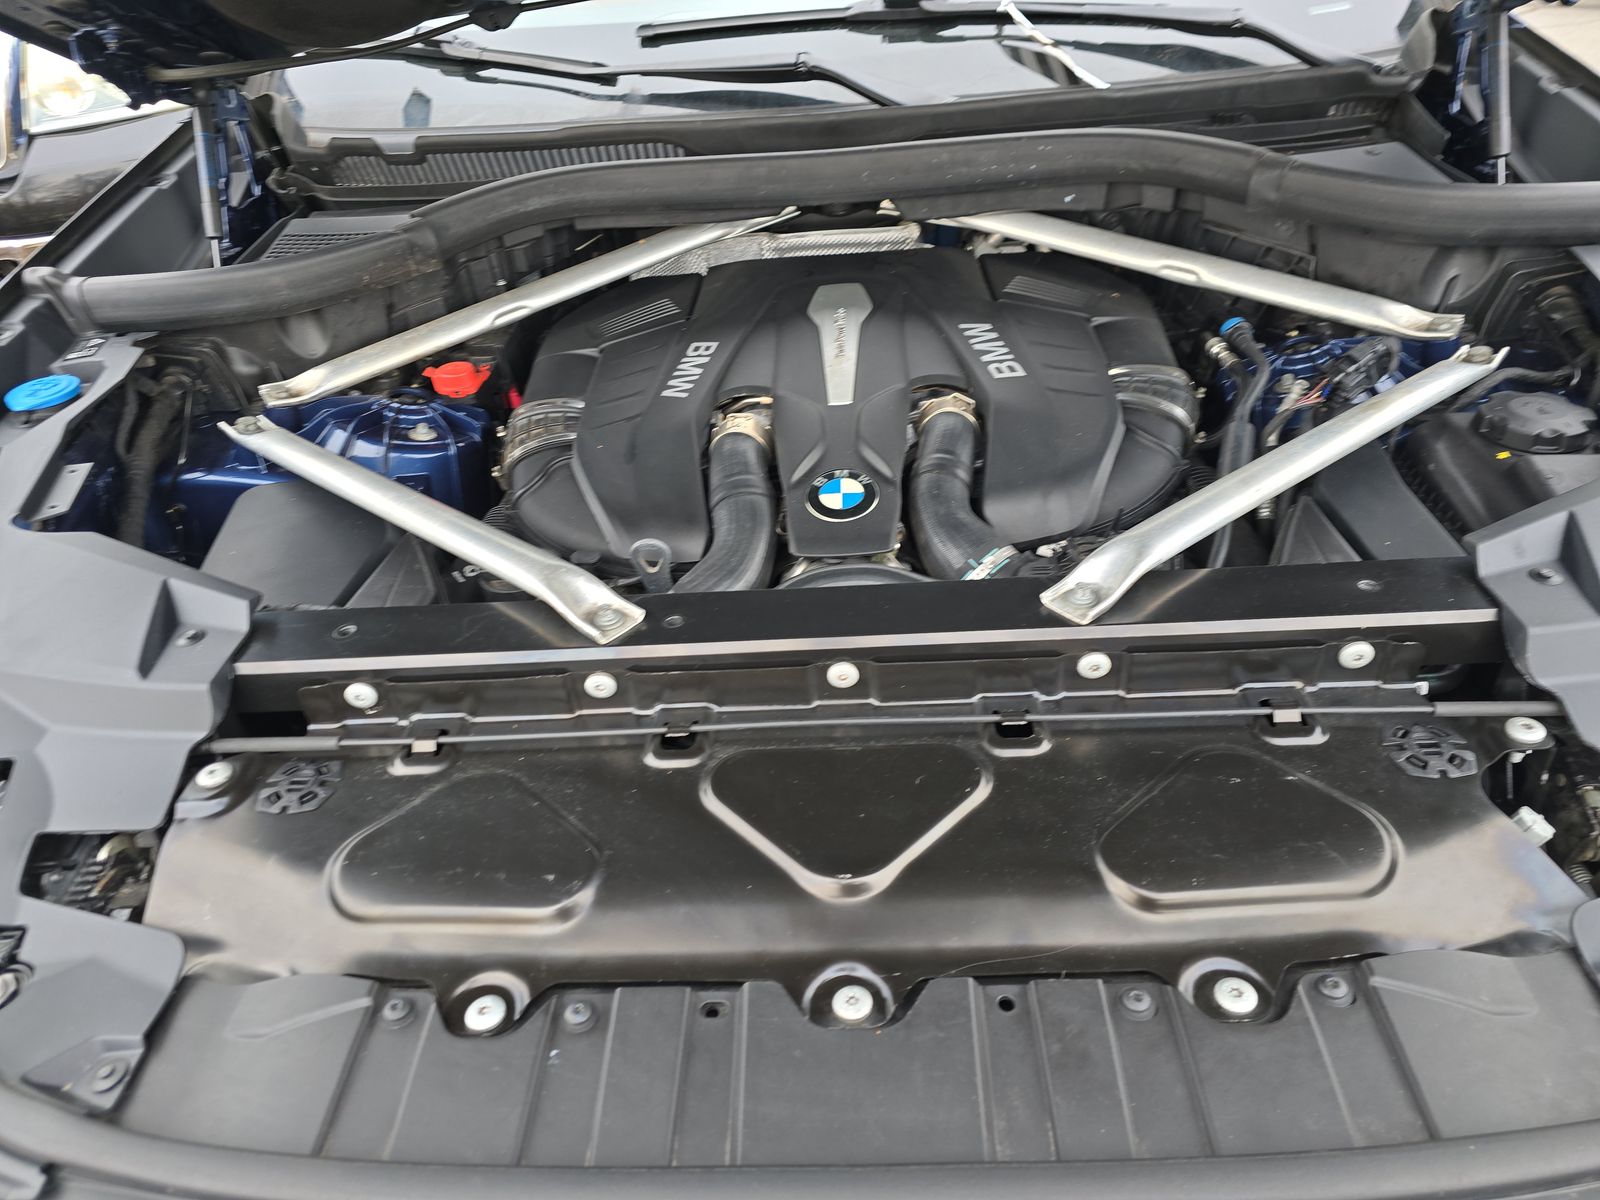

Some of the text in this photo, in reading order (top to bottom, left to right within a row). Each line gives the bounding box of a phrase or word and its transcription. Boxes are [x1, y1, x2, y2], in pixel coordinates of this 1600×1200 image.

[660, 341, 720, 398] BMW
[957, 323, 1028, 379] BMW
[811, 469, 873, 487] BMW
